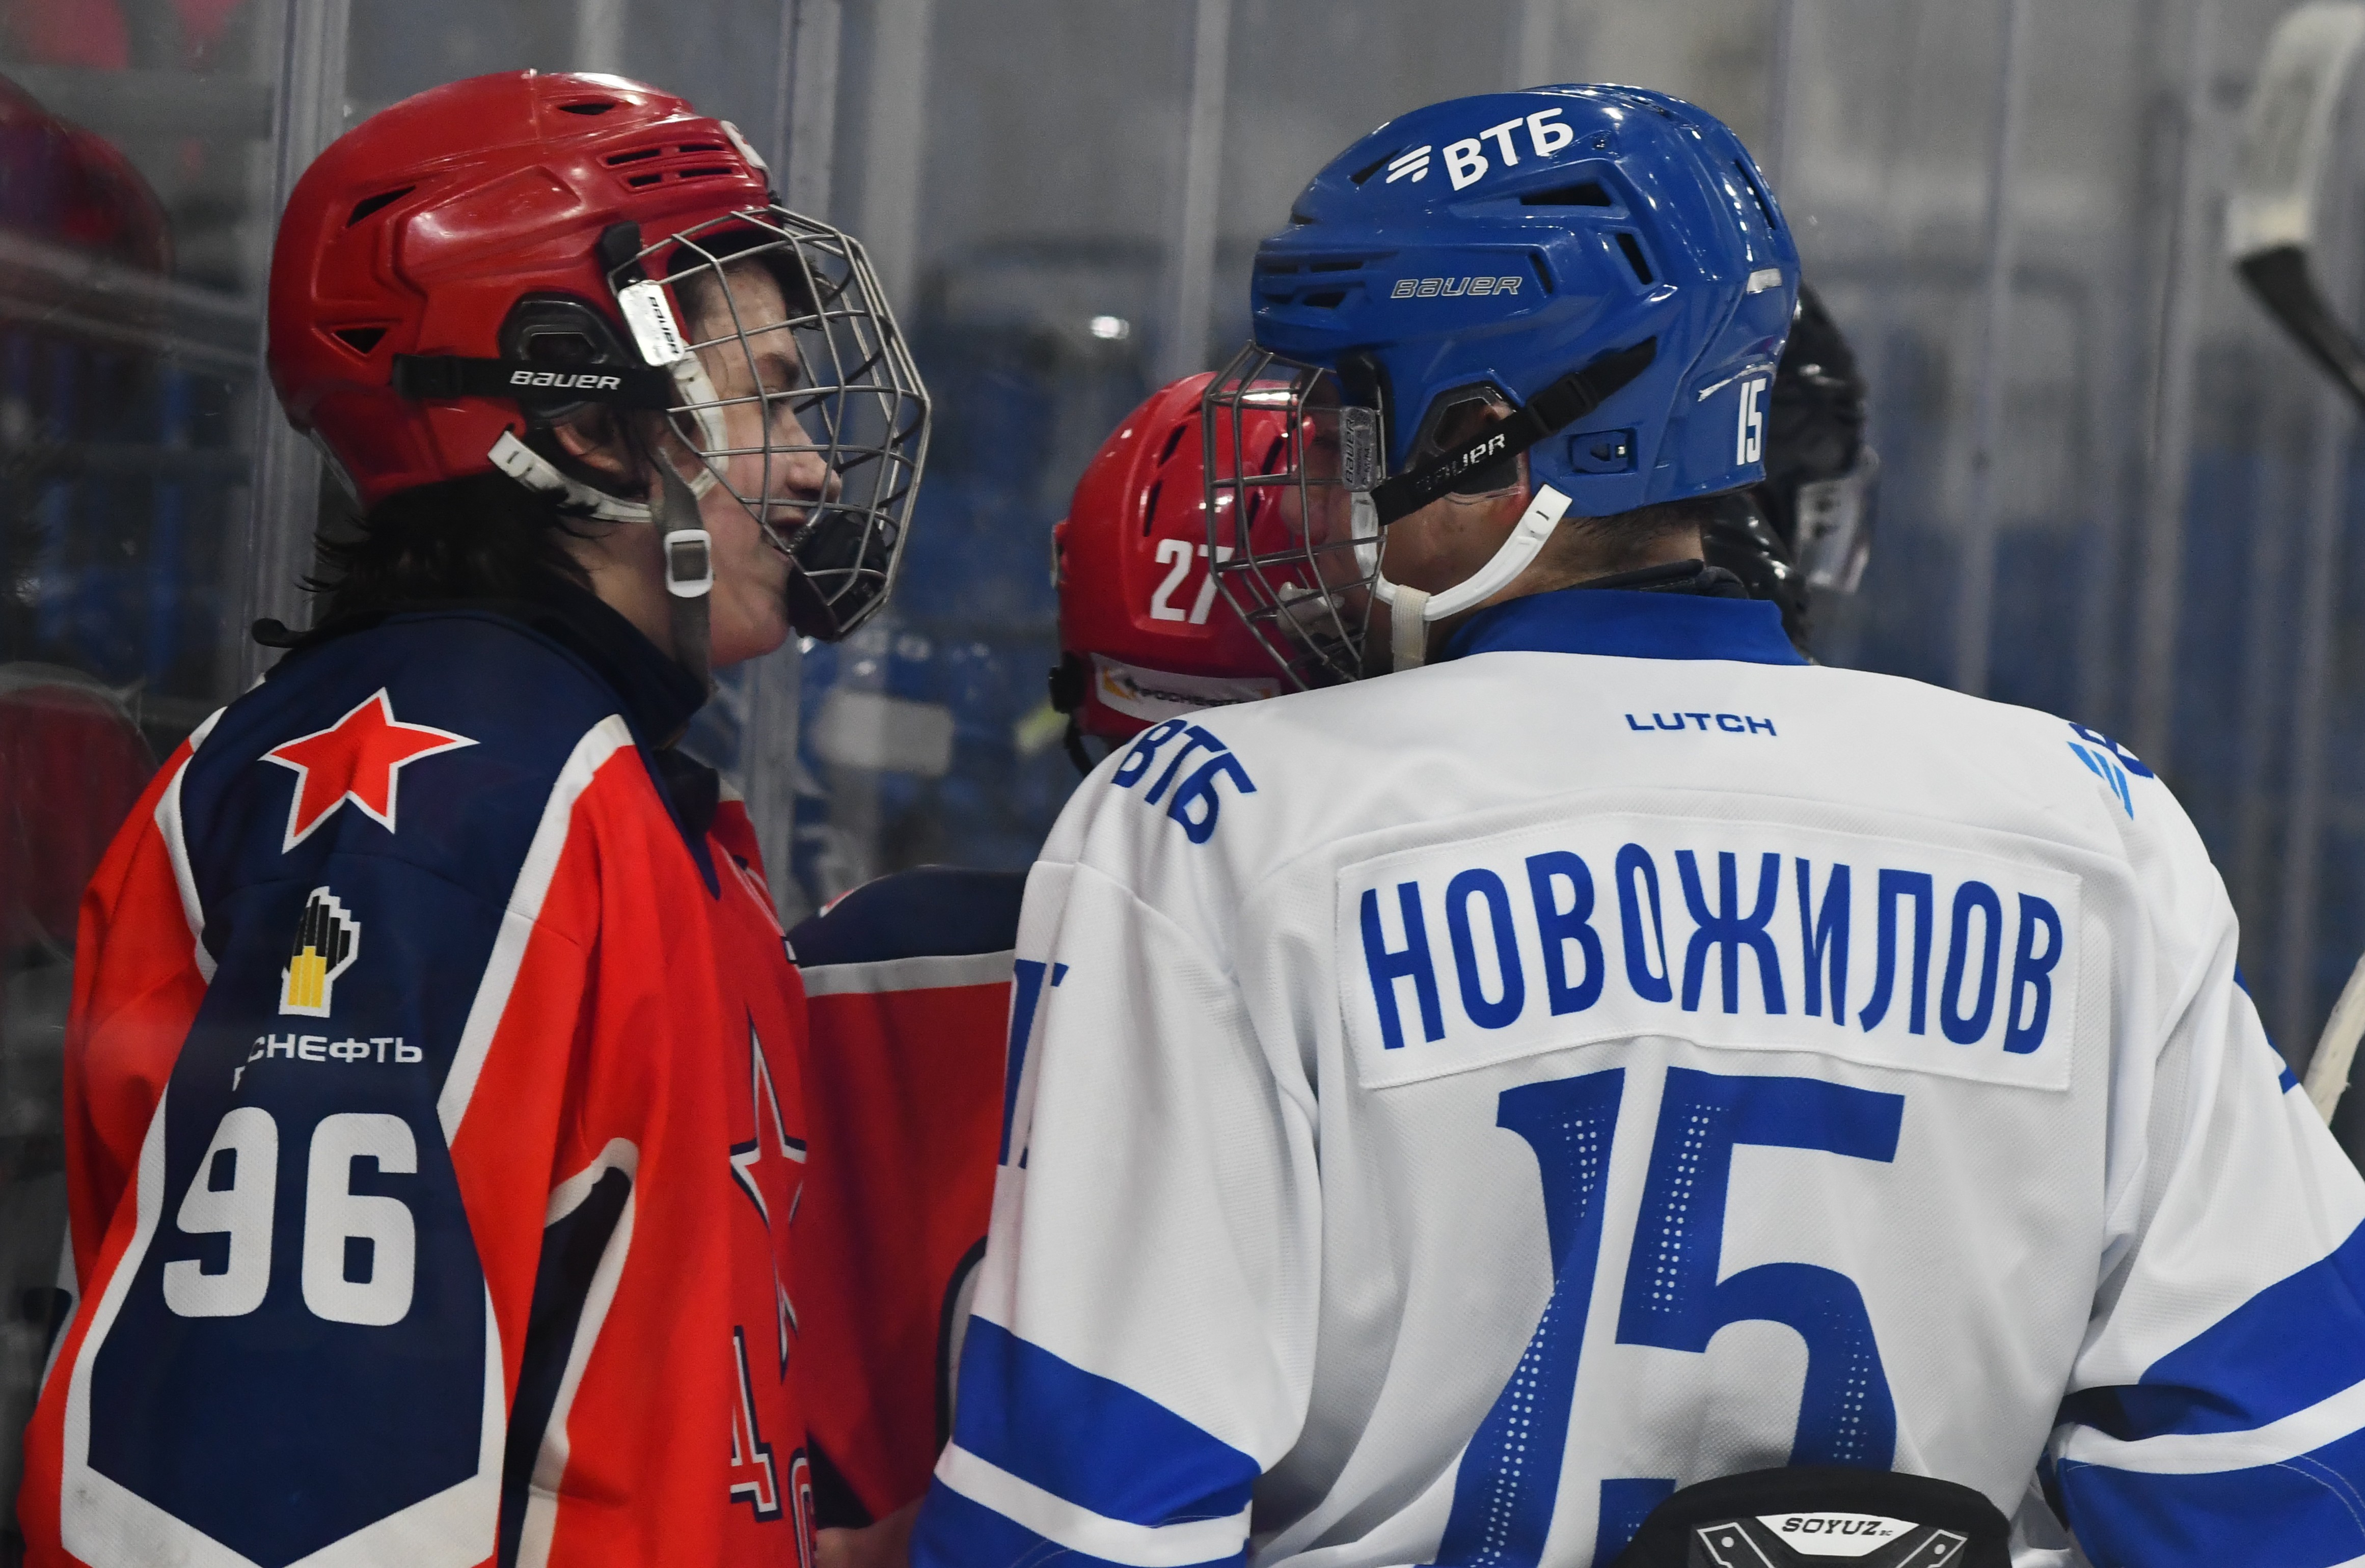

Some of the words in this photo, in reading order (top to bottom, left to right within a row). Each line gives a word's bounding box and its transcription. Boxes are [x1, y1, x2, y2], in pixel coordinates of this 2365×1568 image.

[1443, 107, 1574, 191] ВТБ
[1390, 276, 1523, 299] BAUER
[509, 370, 621, 390] BAUER
[1736, 377, 1767, 465] 15
[1416, 433, 1506, 491] AUER
[1150, 538, 1235, 625] 27
[1624, 712, 1777, 737] LUTCH
[1110, 719, 1257, 844] ВТБ
[1360, 842, 2063, 1055] НОВОЖИЛОВ
[162, 1106, 418, 1327] 96
[1416, 1065, 1906, 1568] 15
[1782, 1517, 1883, 1536] SOYUZ
